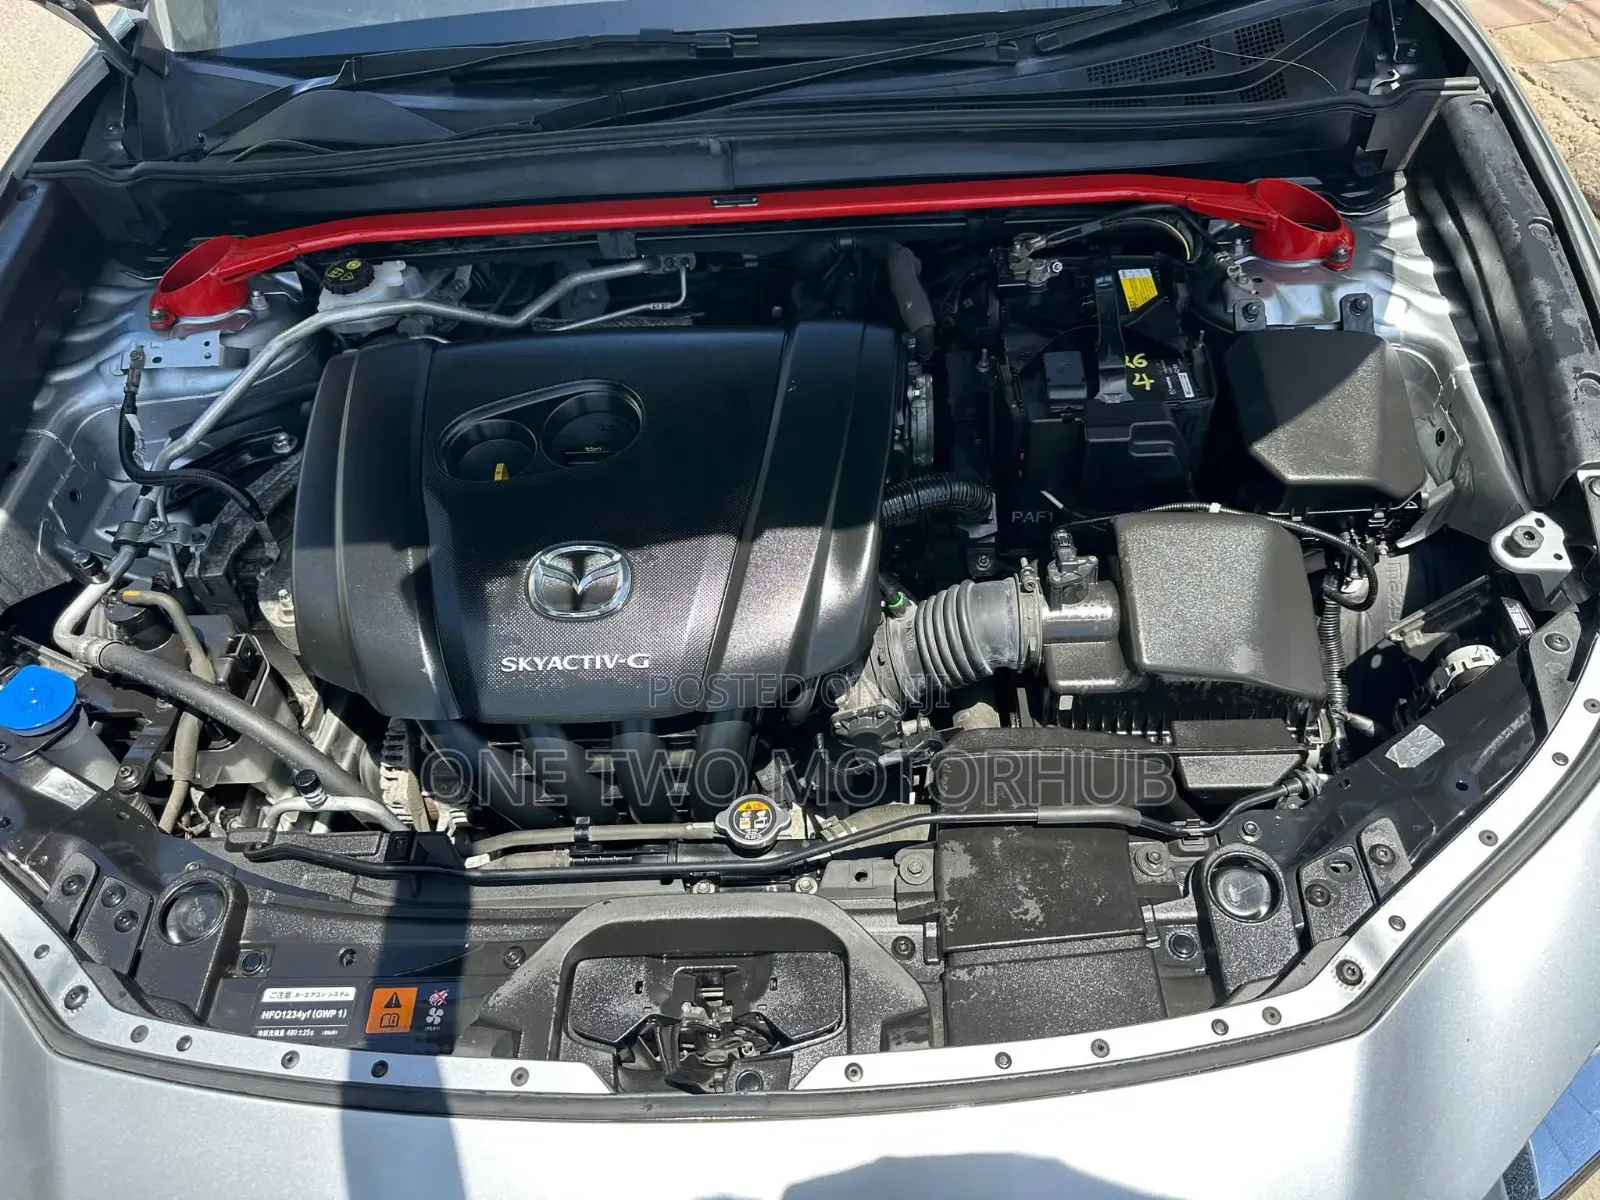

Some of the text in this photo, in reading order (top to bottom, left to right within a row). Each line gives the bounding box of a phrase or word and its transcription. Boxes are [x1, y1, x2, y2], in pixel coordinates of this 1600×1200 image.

[1132, 373, 1155, 391] 4
[500, 653, 650, 672] SKYACTIV-G
[261, 1009, 312, 1020] HFO1234yf
